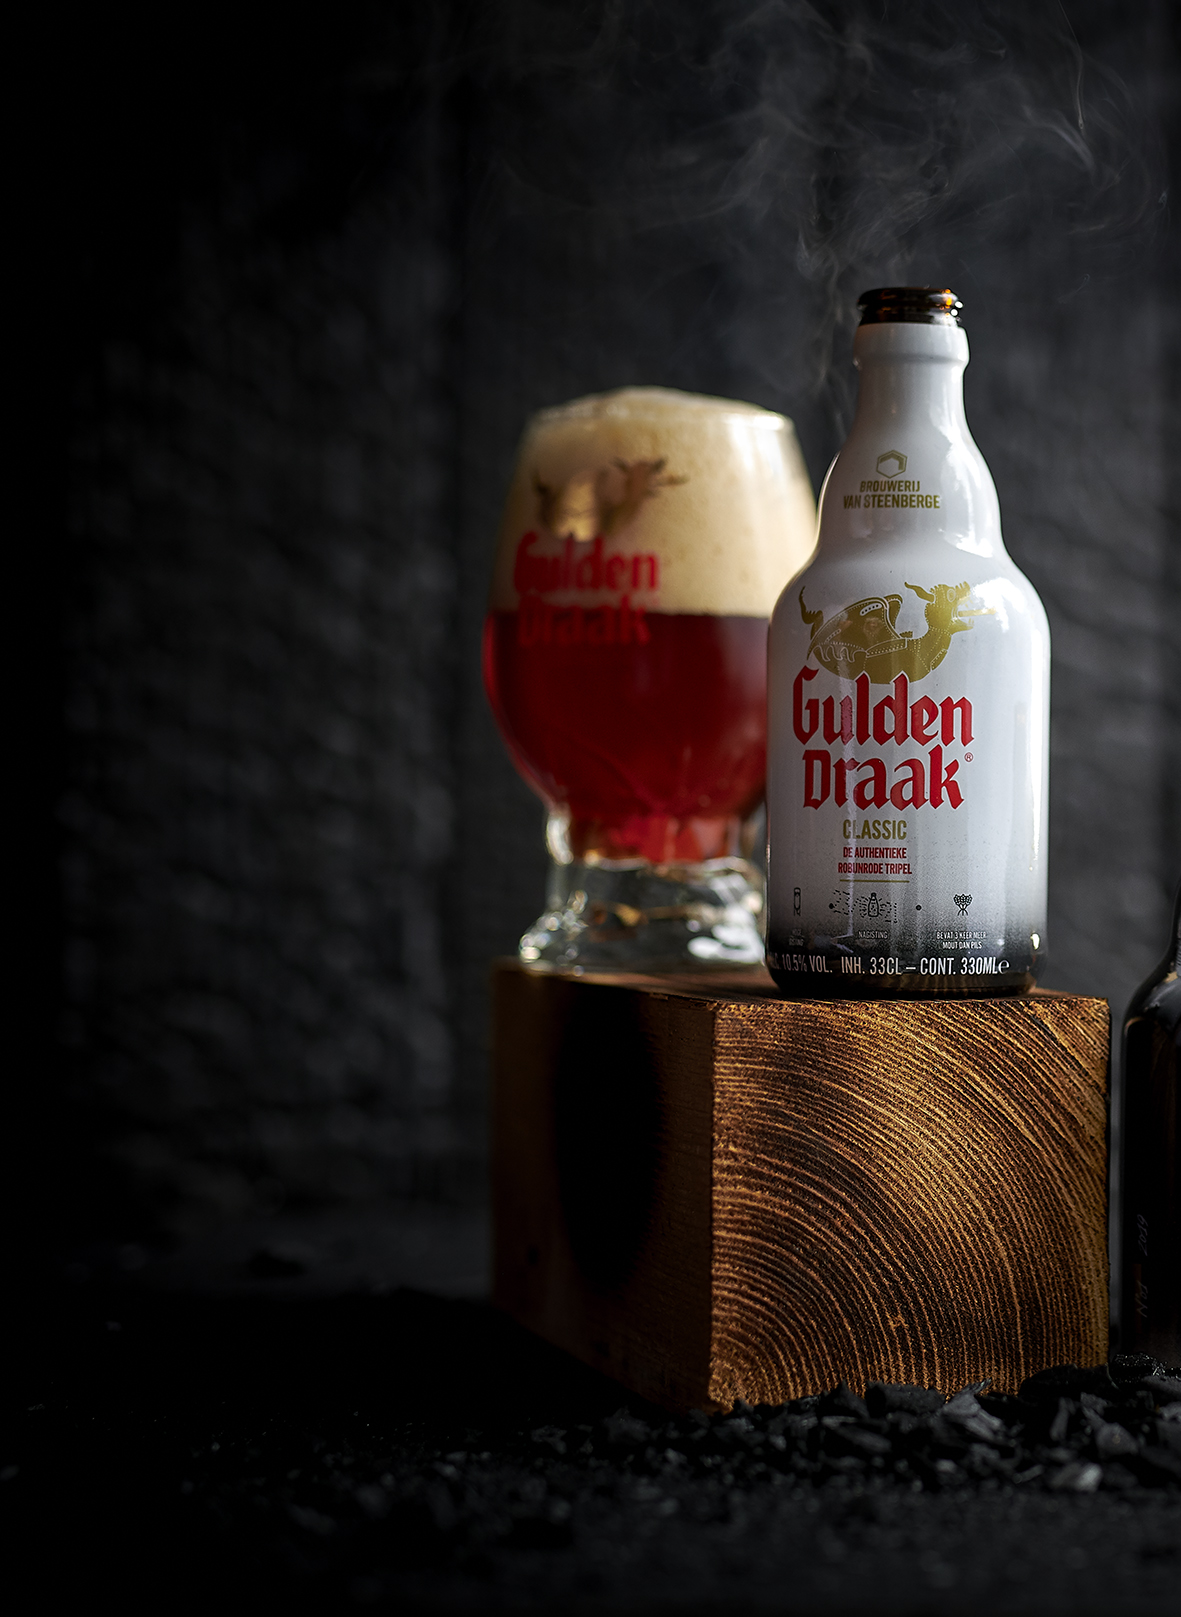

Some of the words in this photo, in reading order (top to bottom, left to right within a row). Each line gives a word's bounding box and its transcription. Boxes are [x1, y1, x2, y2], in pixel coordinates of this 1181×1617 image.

[860, 480, 920, 492] BROUWERIJ
[843, 494, 862, 509] VAN
[863, 494, 941, 509] STEENBERGE
[793, 665, 975, 747] Gulden
[802, 744, 965, 811] Draak
[842, 819, 907, 840] CLASSIC
[843, 846, 853, 858] DE
[854, 847, 907, 859] AUTHENTIEKE
[885, 863, 912, 874] TRIPEL
[809, 955, 833, 973] VOL.
[841, 956, 866, 975] INH.
[869, 956, 902, 976] 33CL
[920, 957, 956, 976] CONT.
